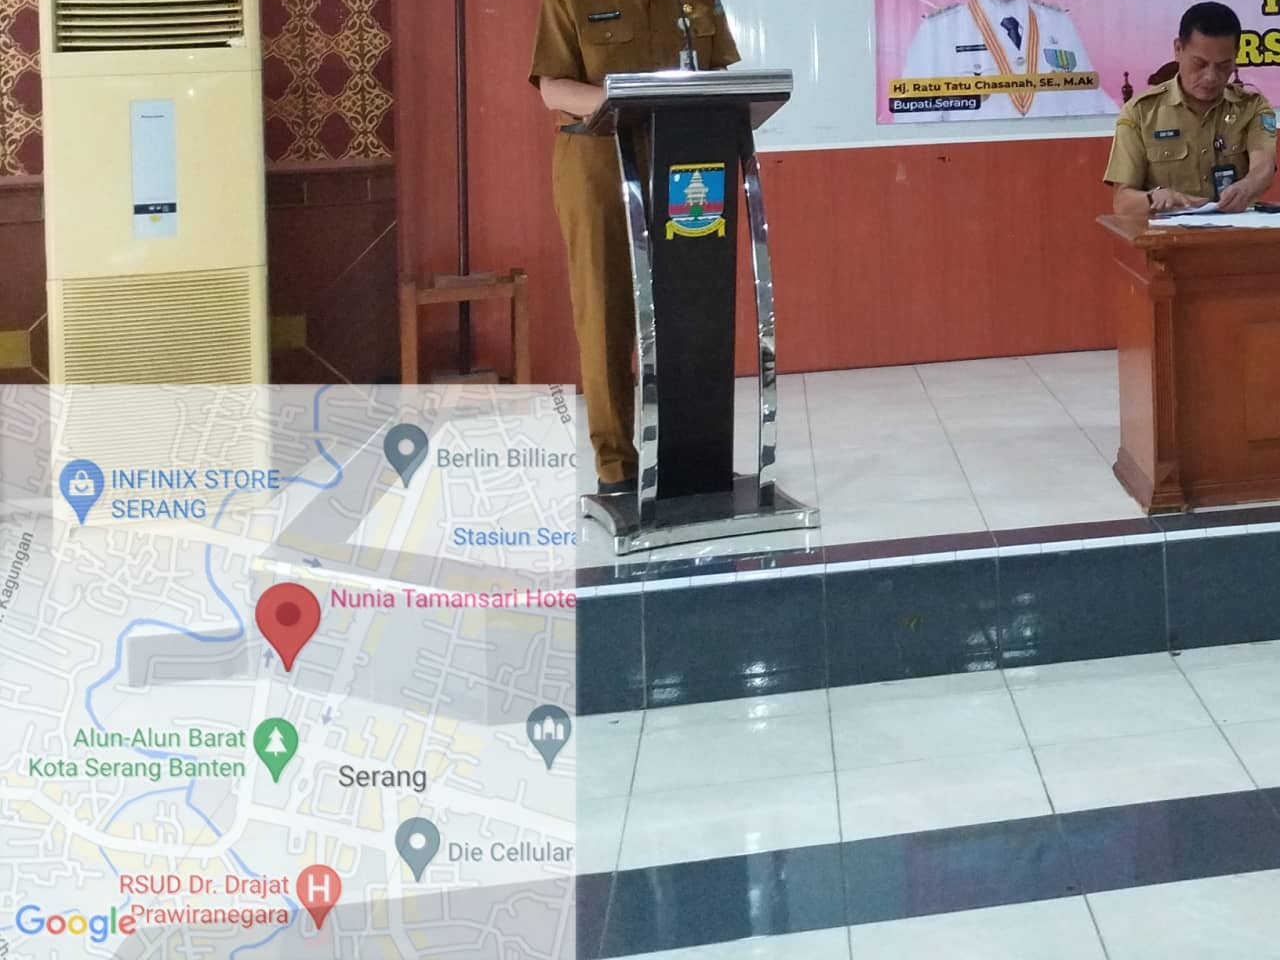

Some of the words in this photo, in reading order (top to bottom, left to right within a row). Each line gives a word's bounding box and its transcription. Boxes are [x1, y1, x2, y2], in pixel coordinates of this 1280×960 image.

[893, 83, 909, 94] Hj.
[913, 82, 941, 92] Ratu
[944, 81, 971, 91] Tatu
[974, 78, 1036, 90] Chasanah,
[1063, 76, 1094, 86] M.Ak
[893, 99, 933, 111] Bupati
[934, 97, 977, 109] Serang
